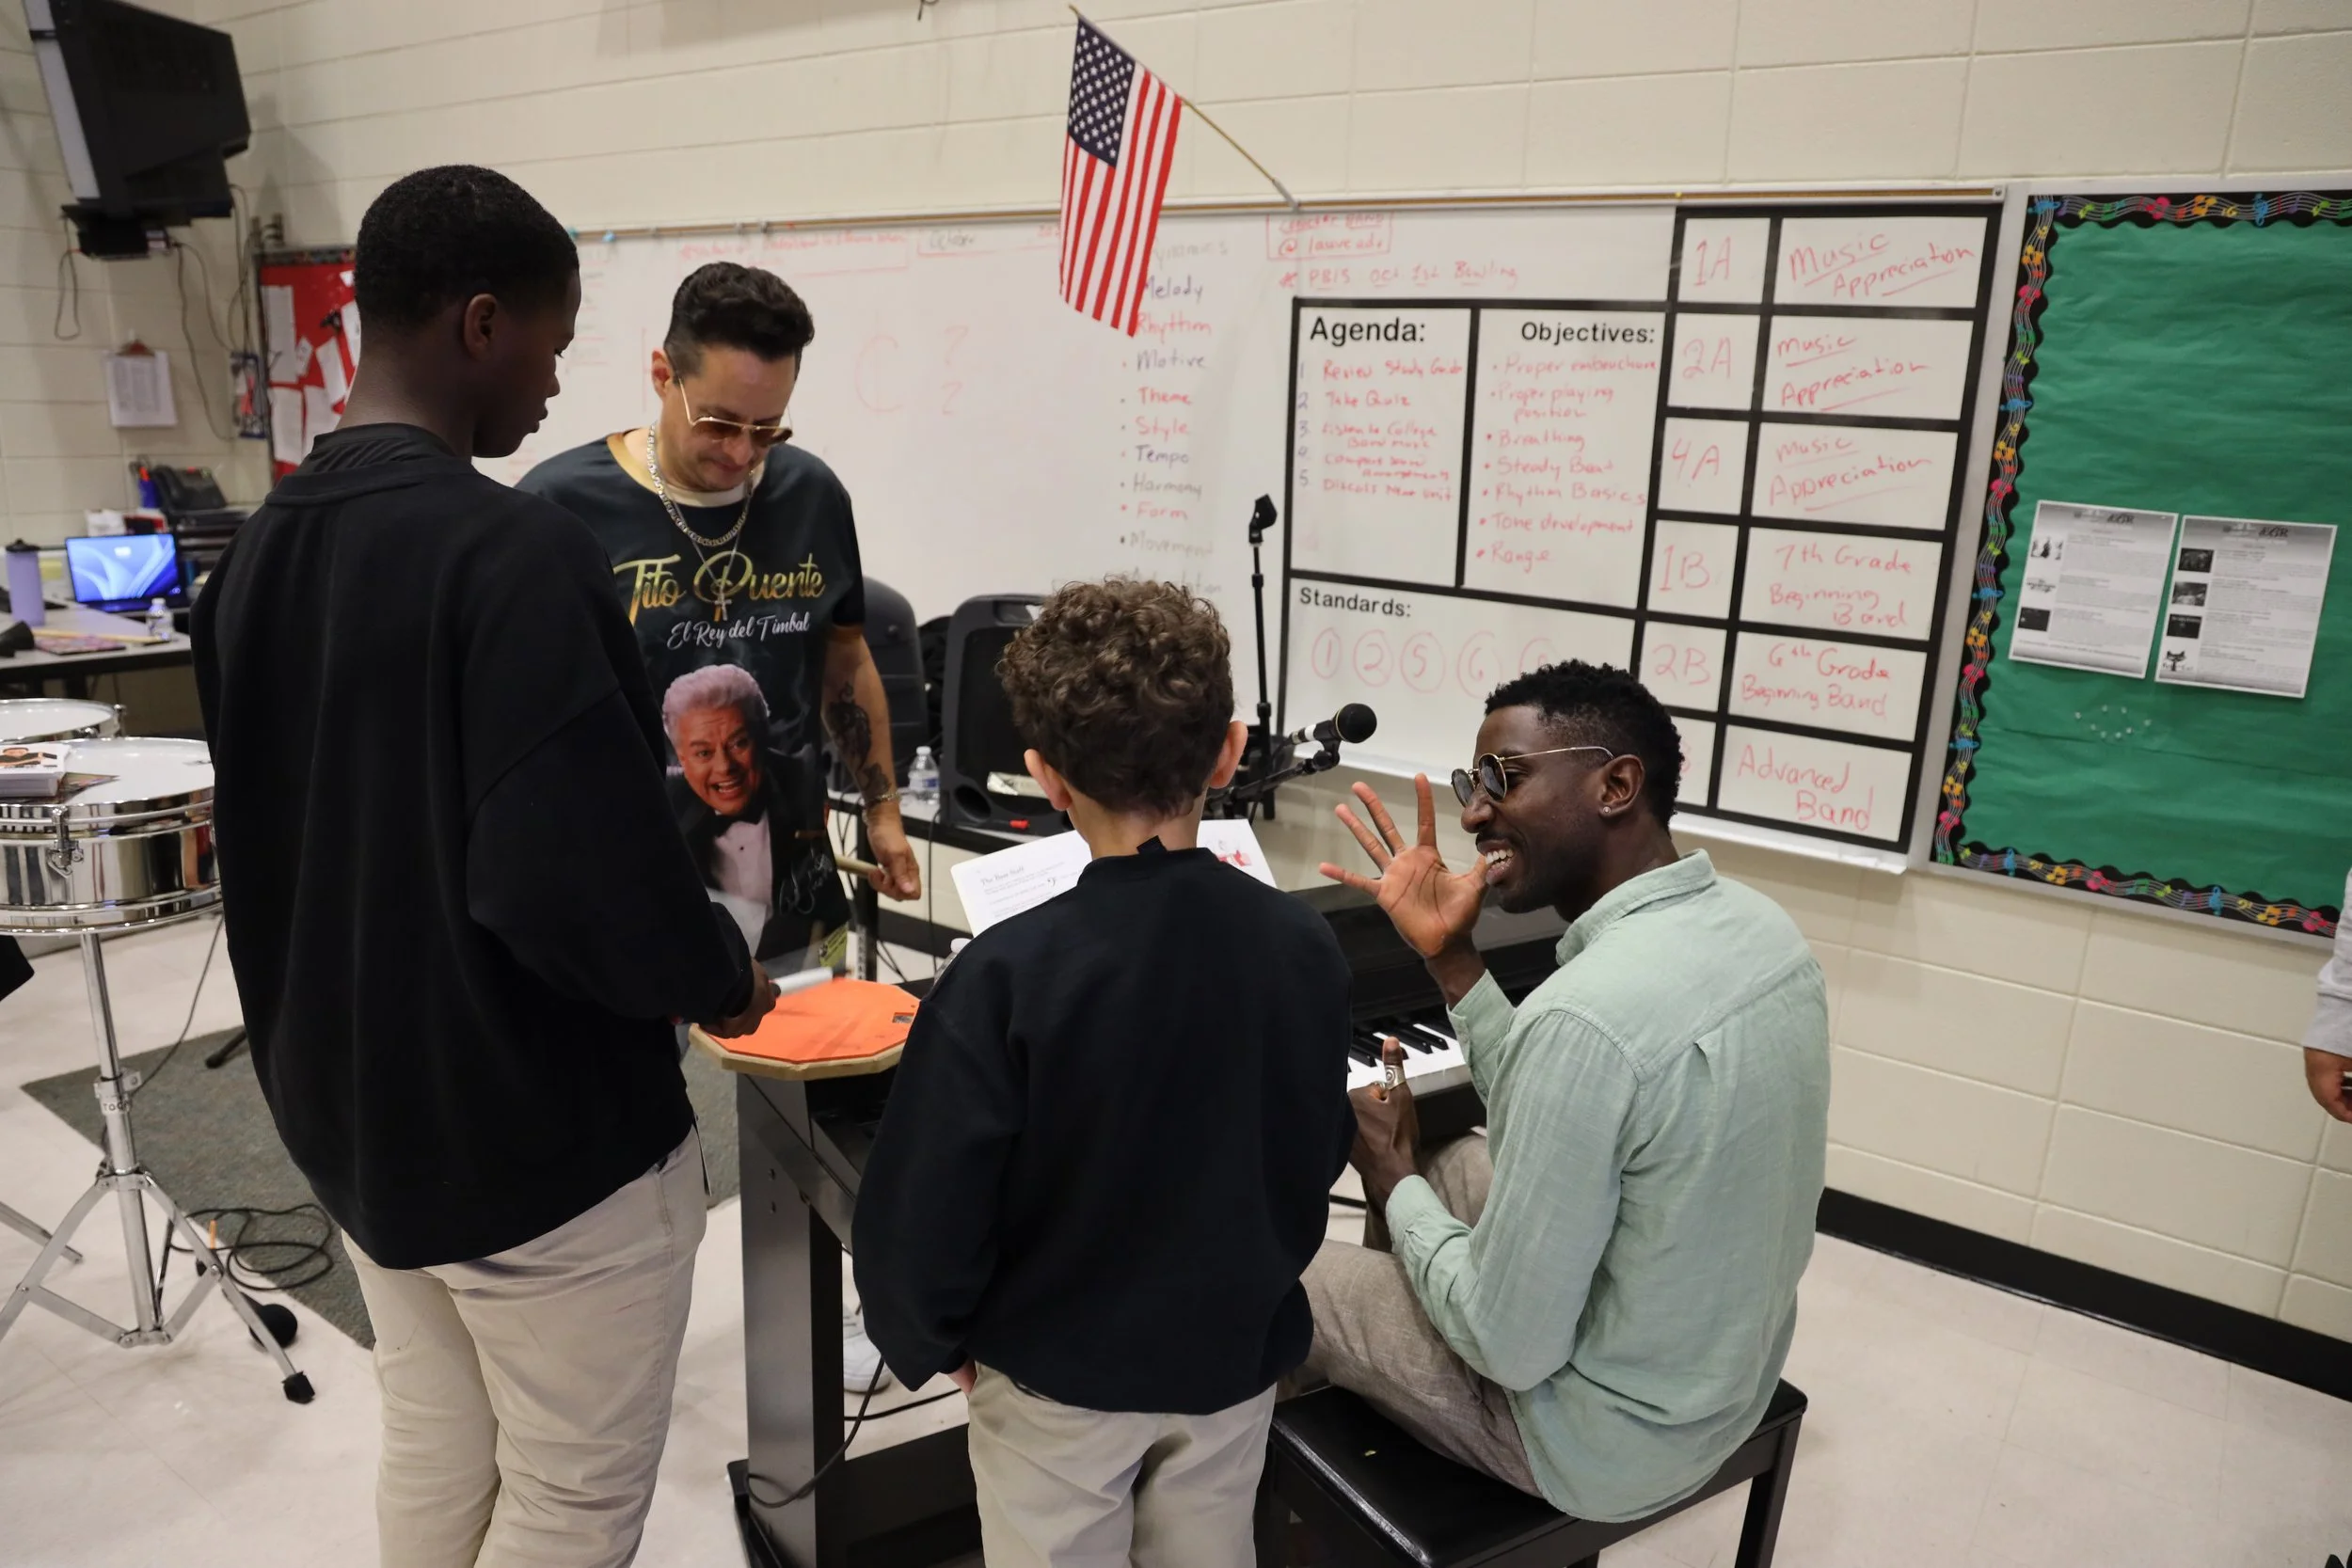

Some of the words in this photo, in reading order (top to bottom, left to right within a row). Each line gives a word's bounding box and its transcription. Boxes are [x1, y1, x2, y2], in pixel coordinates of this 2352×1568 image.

[1693, 235, 1733, 287] 1A
[1788, 232, 1890, 282] Music
[1833, 242, 1975, 298] Appreciation
[1310, 316, 1425, 347] Agenda:
[1521, 321, 1656, 346] Objectives:
[1505, 352, 1563, 379] Proper
[1682, 337, 1732, 380] 2A
[1138, 386, 1192, 404] Theme
[1499, 382, 1545, 406] Proper
[1552, 384, 1614, 404] playing
[1781, 357, 1929, 406] Appreciation
[1297, 391, 1309, 409] 2
[1366, 389, 1411, 407] Quiz
[1136, 417, 1190, 442] Style
[1514, 406, 1587, 426] position
[1499, 429, 1584, 451] Breathing
[1136, 444, 1189, 468] Tempo
[1498, 456, 1561, 482] Steady
[1671, 437, 1721, 480] 4A
[1133, 472, 1202, 501] Harmony
[1496, 483, 1562, 507] Rhythm
[1572, 482, 1646, 505] Basics
[1770, 455, 1932, 506] Appreciation
[1136, 500, 1187, 519] Form
[1492, 513, 1533, 531] Tone
[1540, 511, 1633, 538] development
[1491, 541, 1550, 574] Range
[1659, 545, 1710, 592] 1B
[1775, 542, 1823, 571] 7th
[1835, 545, 1912, 574] Grade
[613, 554, 687, 627] Tito
[693, 550, 826, 622] Puente
[1299, 587, 1411, 617] Standards:
[1770, 582, 1880, 610] Beginning
[1832, 601, 1907, 627] Band
[667, 620, 691, 649] El
[693, 621, 725, 648] Rey
[728, 616, 755, 641] del
[756, 611, 810, 641] Timbal
[1653, 643, 1710, 685] 2B
[1769, 642, 1812, 668] 6th
[1817, 646, 1891, 679] Grade
[1740, 674, 1820, 710] Beginning
[1827, 684, 1886, 718] Band
[1738, 744, 1851, 794] Advanced
[1795, 786, 1873, 832] Band
